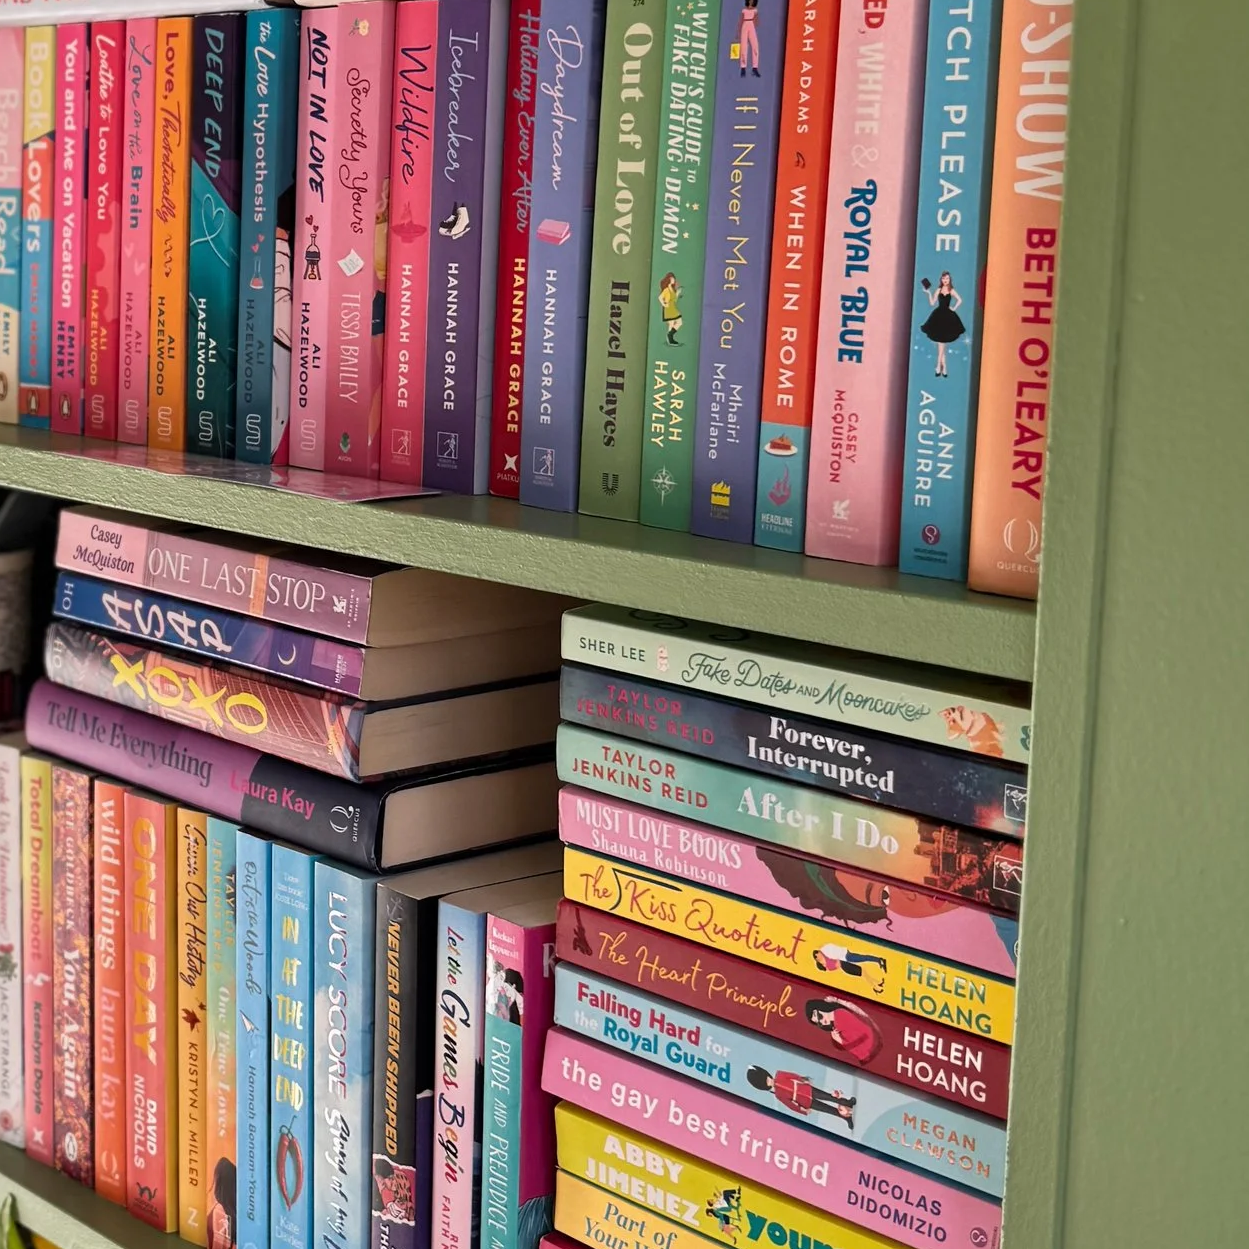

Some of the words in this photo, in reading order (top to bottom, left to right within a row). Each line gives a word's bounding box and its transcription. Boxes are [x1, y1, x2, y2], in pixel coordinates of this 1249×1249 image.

[621, 22, 653, 102] Out
[797, 61, 812, 133] ADAMS
[619, 113, 642, 150] of
[612, 158, 645, 255] Love
[935, 104, 967, 253] PLEASE
[785, 186, 807, 270] WHEN
[841, 179, 876, 279] ROYAL
[445, 262, 459, 344] HANNAH
[607, 281, 630, 359] Hazel
[783, 282, 800, 310] IN
[837, 285, 869, 365] BLUE
[443, 350, 456, 410] GRACE
[651, 361, 668, 448] HAWLEY
[777, 327, 797, 407] ROME
[599, 369, 625, 448] Hayes
[669, 370, 685, 441] SARAH
[913, 389, 933, 509] AGUIRRE
[937, 422, 953, 480] ANN
[90, 524, 122, 549] Casey
[761, 513, 793, 527] HEADLINE
[72, 548, 135, 574] McQuiston
[148, 548, 191, 584] ONE
[200, 557, 260, 599] LAST
[266, 572, 326, 613] STOP
[579, 636, 617, 657] SHER
[620, 646, 646, 662] LEE
[681, 653, 732, 684] Fake
[734, 659, 796, 698] Dates
[796, 684, 820, 698] AND
[818, 680, 931, 722] Mooncakes
[747, 736, 895, 794] Interrupted
[768, 716, 873, 765] Forever,
[132, 817, 157, 940] ONE
[388, 920, 402, 995] NEVER
[132, 950, 157, 1065] DAY
[387, 995, 400, 1057] BEEN
[576, 981, 642, 1029] Falling
[648, 1013, 701, 1048] Hard
[705, 1034, 732, 1059] for
[573, 1010, 599, 1031] the
[603, 1020, 660, 1058] Royal
[665, 1043, 732, 1085] Guard
[895, 1057, 987, 1104] HOANG
[901, 1026, 984, 1072] HELEN
[384, 1058, 400, 1156] SHIPPED
[561, 1057, 603, 1092] the
[611, 1080, 660, 1120] gay
[669, 1100, 730, 1148] best
[740, 1128, 830, 1187] friend
[847, 1189, 948, 1243] DIDOMIZIO
[857, 1170, 944, 1216] NICOLAS
